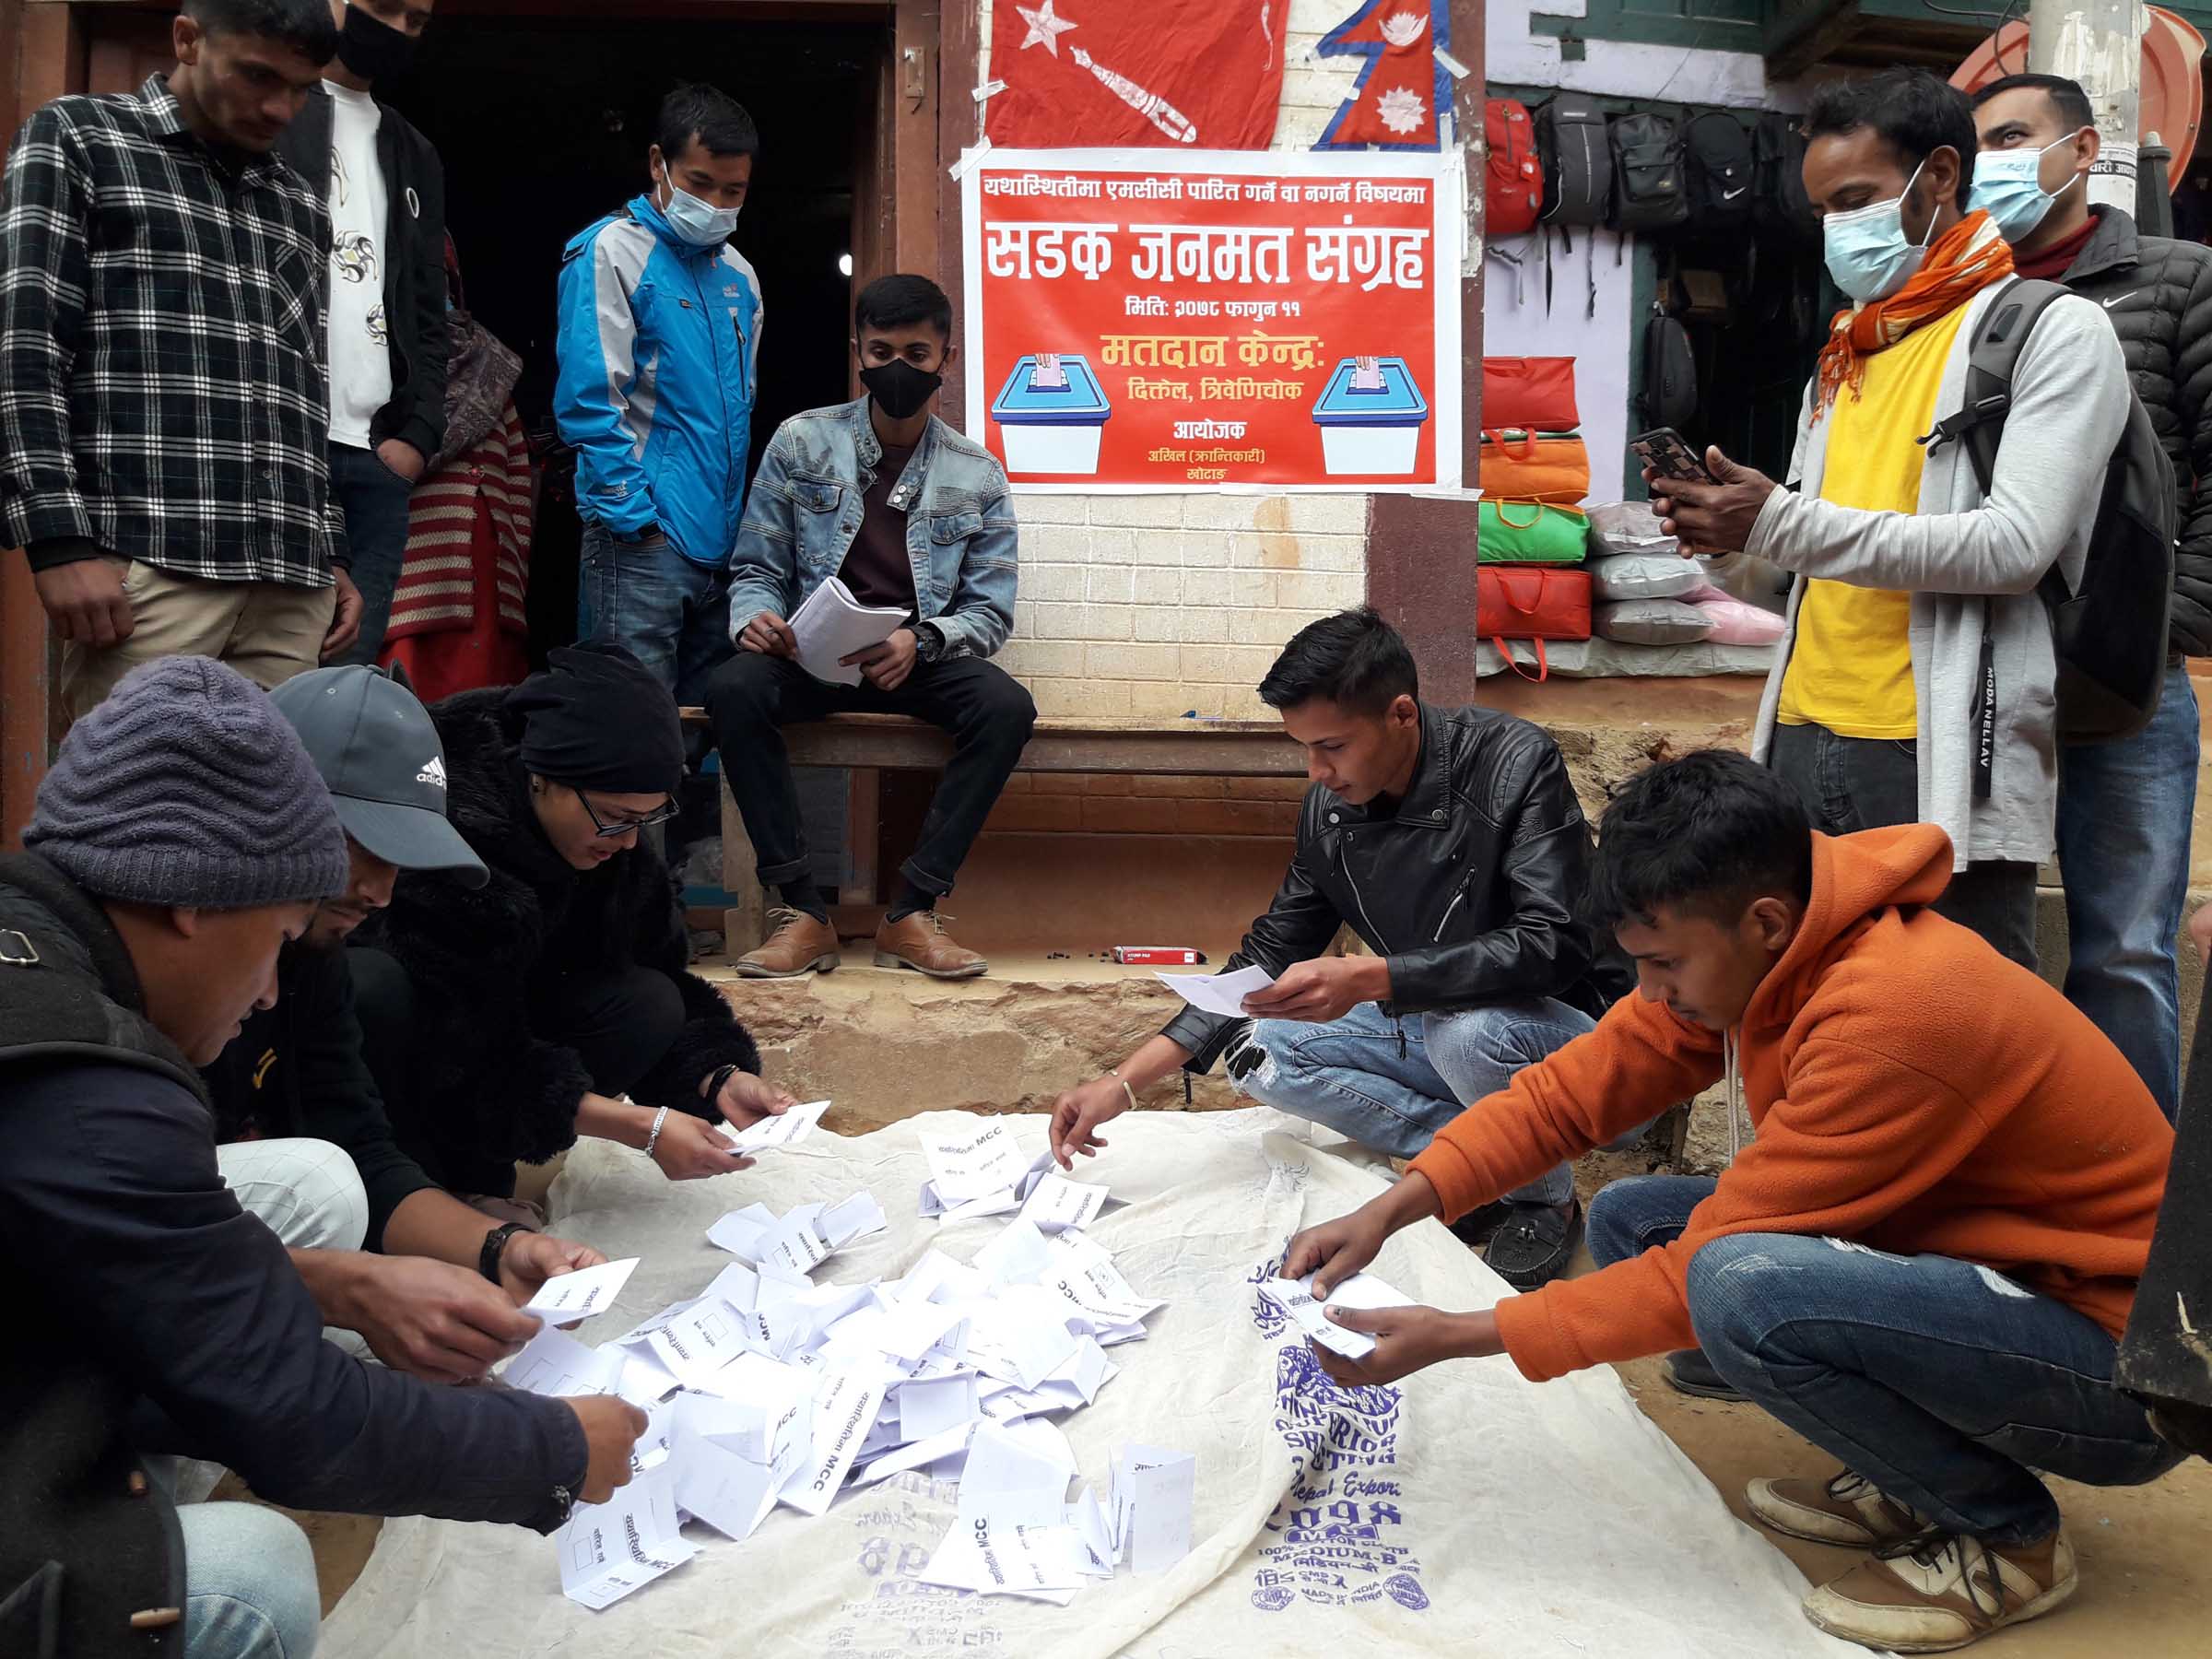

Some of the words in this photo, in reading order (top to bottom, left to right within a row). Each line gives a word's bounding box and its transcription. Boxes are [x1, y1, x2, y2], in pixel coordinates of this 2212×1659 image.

[1106, 178, 1183, 200] एमसीसी
[1187, 178, 1241, 201] पारित
[1245, 182, 1277, 203] गर्ने
[1281, 185, 1300, 203] वा
[1305, 182, 1350, 203] नगर्ने
[1355, 182, 1427, 204] विषयमा
[985, 221, 1119, 280] सडक
[1129, 224, 1294, 284] जनमत
[1305, 214, 1430, 292] संग्रह
[1175, 300, 1220, 317] २०७८
[1224, 300, 1277, 322] फागुन
[1281, 301, 1300, 317] ११
[1100, 335, 1229, 369] मतदान
[1173, 418, 1247, 439] आयोजक
[1148, 447, 1186, 463] अखिल
[1985, 666, 1994, 706] MODA
[1980, 709, 1992, 768] NELLAV
[976, 1126, 1002, 1147] MCC
[813, 1454, 840, 1492] MCC
[974, 1517, 991, 1548] MCC
